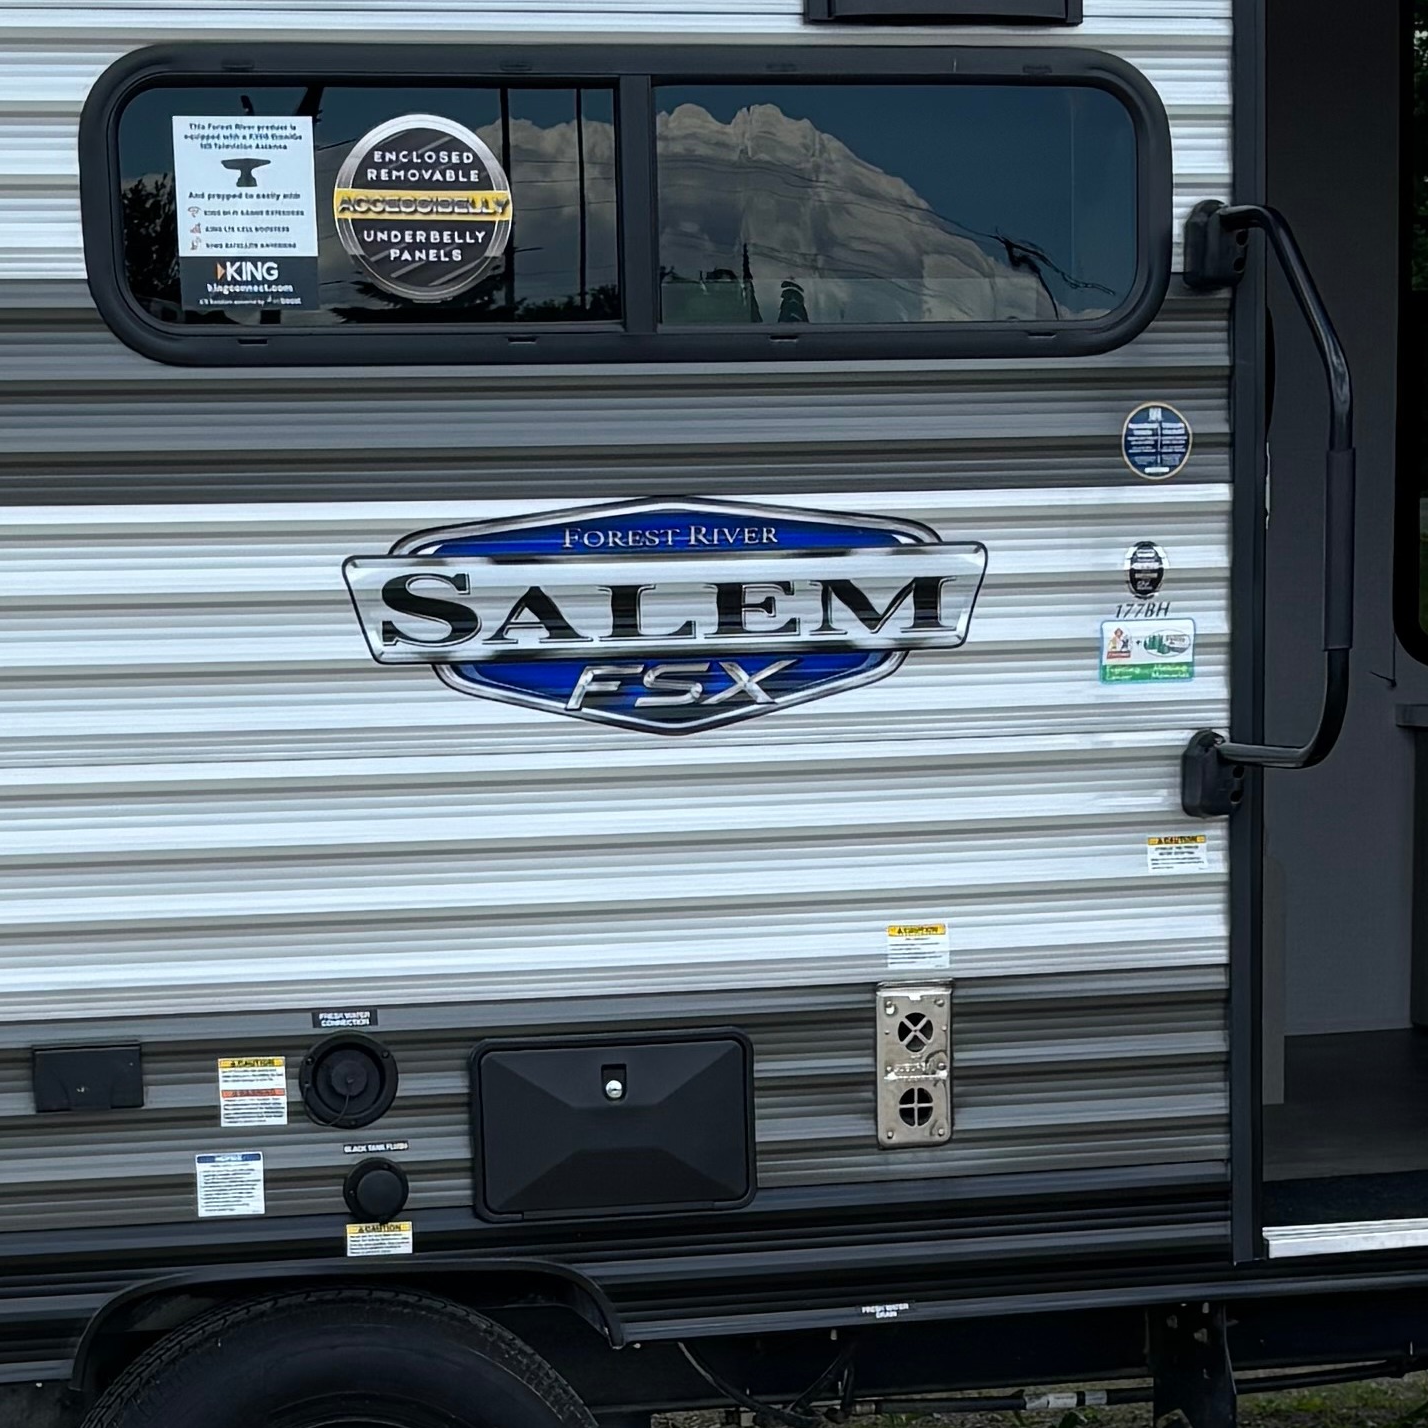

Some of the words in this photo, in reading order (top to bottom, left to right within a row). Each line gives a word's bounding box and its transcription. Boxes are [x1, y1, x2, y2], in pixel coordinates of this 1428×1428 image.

[373, 150, 474, 164] ENCLOSED
[367, 168, 479, 182] REMOVABLE
[363, 230, 486, 244] UNDERBELLY
[389, 249, 463, 262] PANELS
[226, 261, 279, 282] KING
[206, 283, 294, 295] kingconnect.com
[562, 527, 680, 549] FOREST
[687, 524, 779, 547] RIVER
[381, 572, 960, 647] SALEM
[1115, 601, 1172, 619] 177BH
[565, 660, 804, 711] FSX
[344, 1011, 370, 1019] WATER
[321, 1019, 369, 1027] CONNECTION
[365, 1224, 401, 1233] CAUTION
